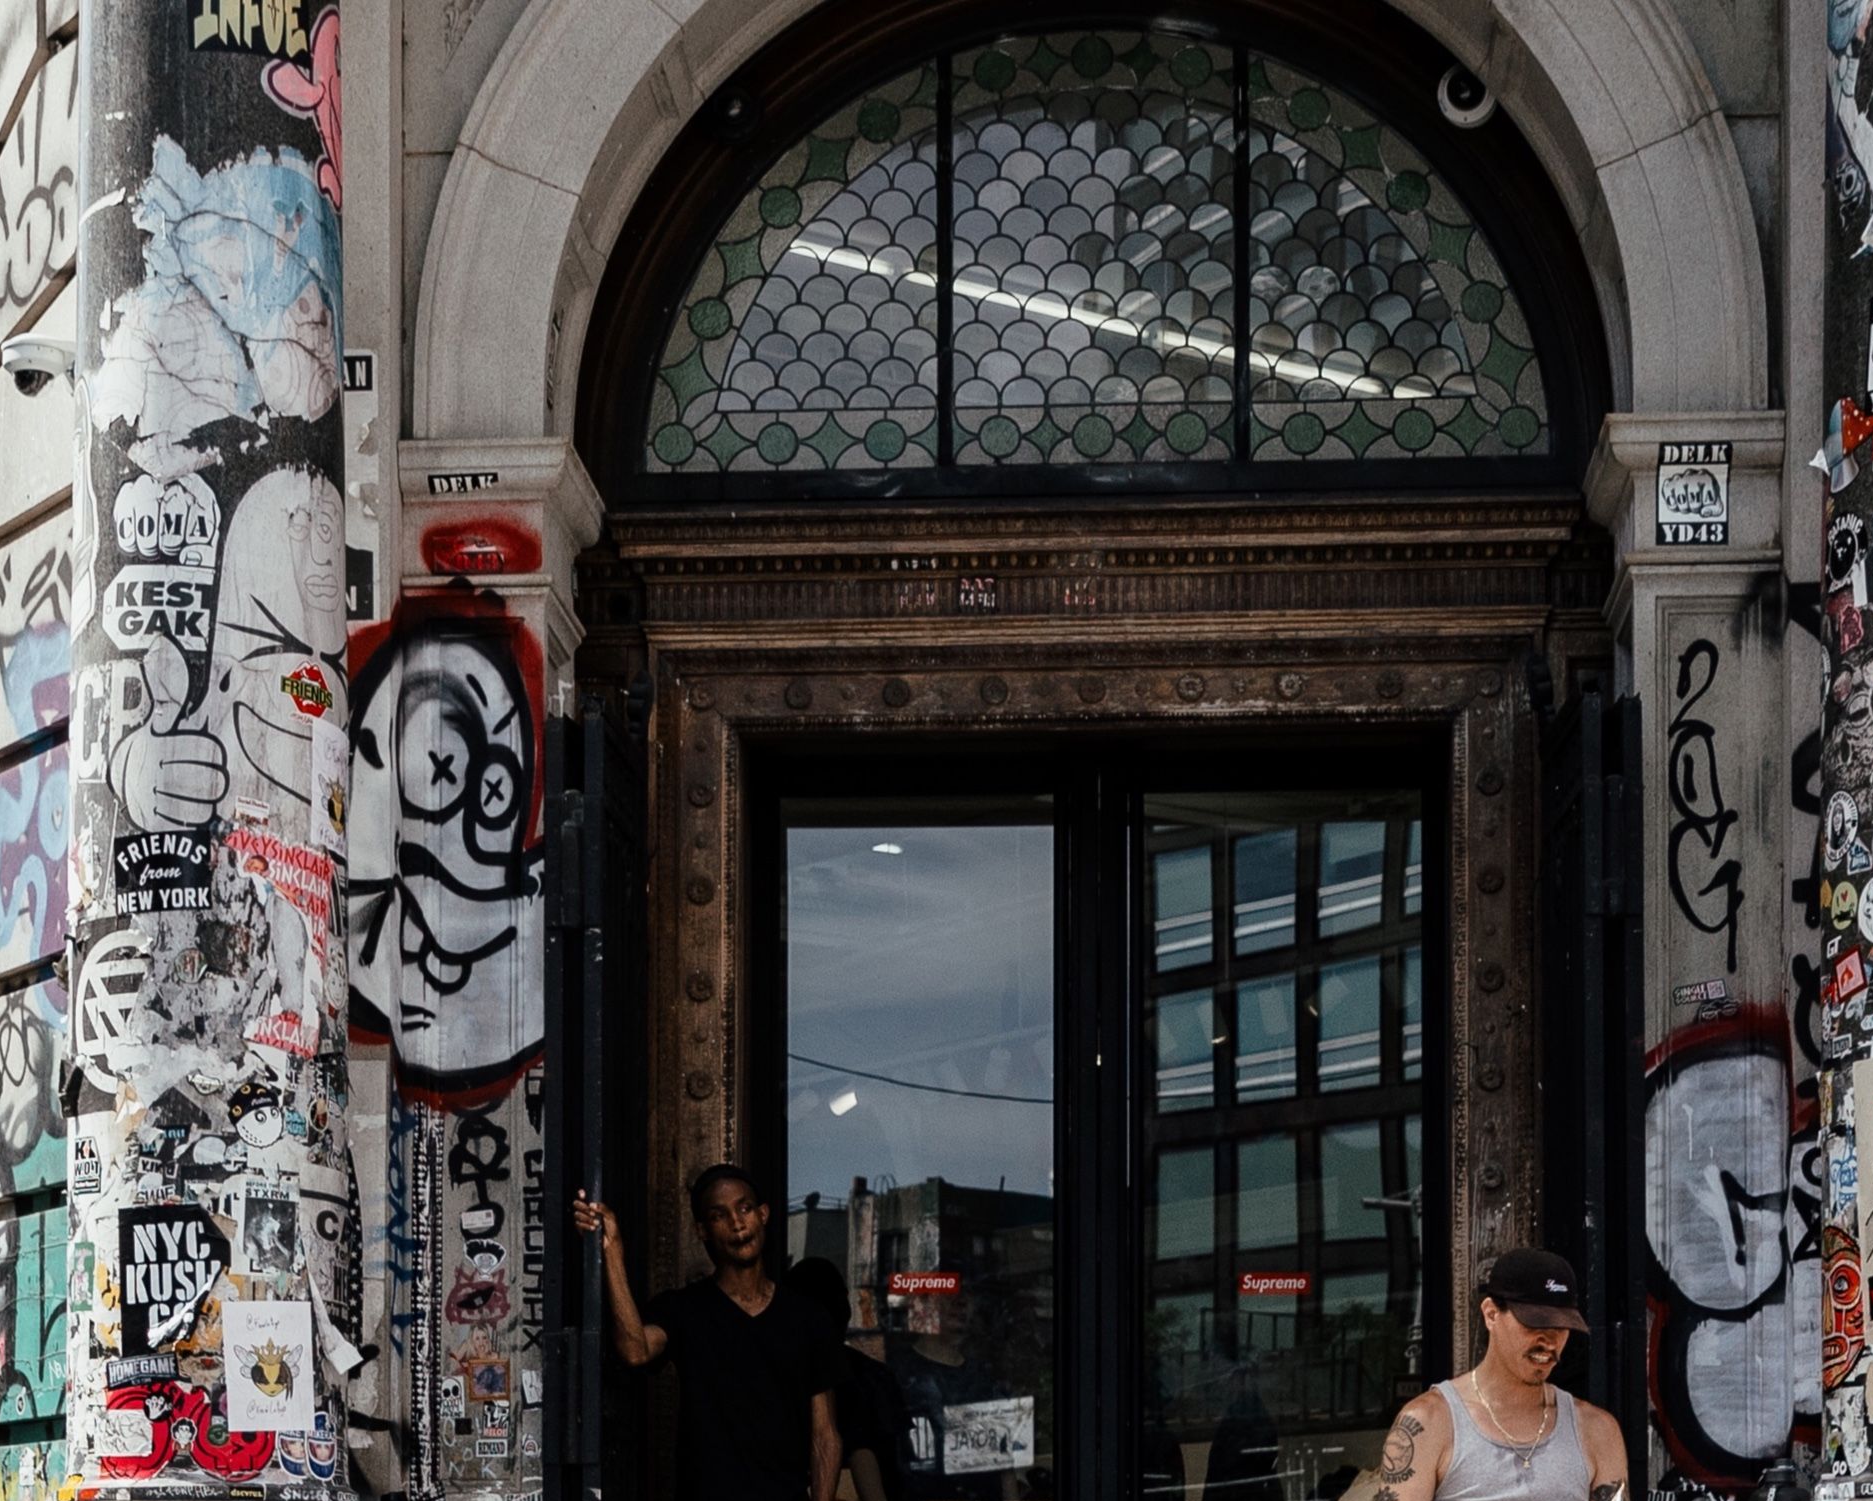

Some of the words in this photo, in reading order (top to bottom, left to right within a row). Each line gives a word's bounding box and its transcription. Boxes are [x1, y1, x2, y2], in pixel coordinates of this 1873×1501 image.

[1663, 445, 1728, 463] DELK
[433, 475, 495, 493] DELK
[118, 512, 209, 541] COMA
[1662, 524, 1724, 543] YD43
[116, 832, 208, 872] FRIENDS
[139, 865, 182, 886] from
[117, 894, 155, 915] NEW
[159, 887, 210, 909] YORK
[245, 1188, 290, 1200] STXRM
[133, 1221, 211, 1264] NYC
[127, 1261, 222, 1305] KUSH
[893, 1273, 956, 1293] Supreme
[1242, 1273, 1307, 1294] Supreme
